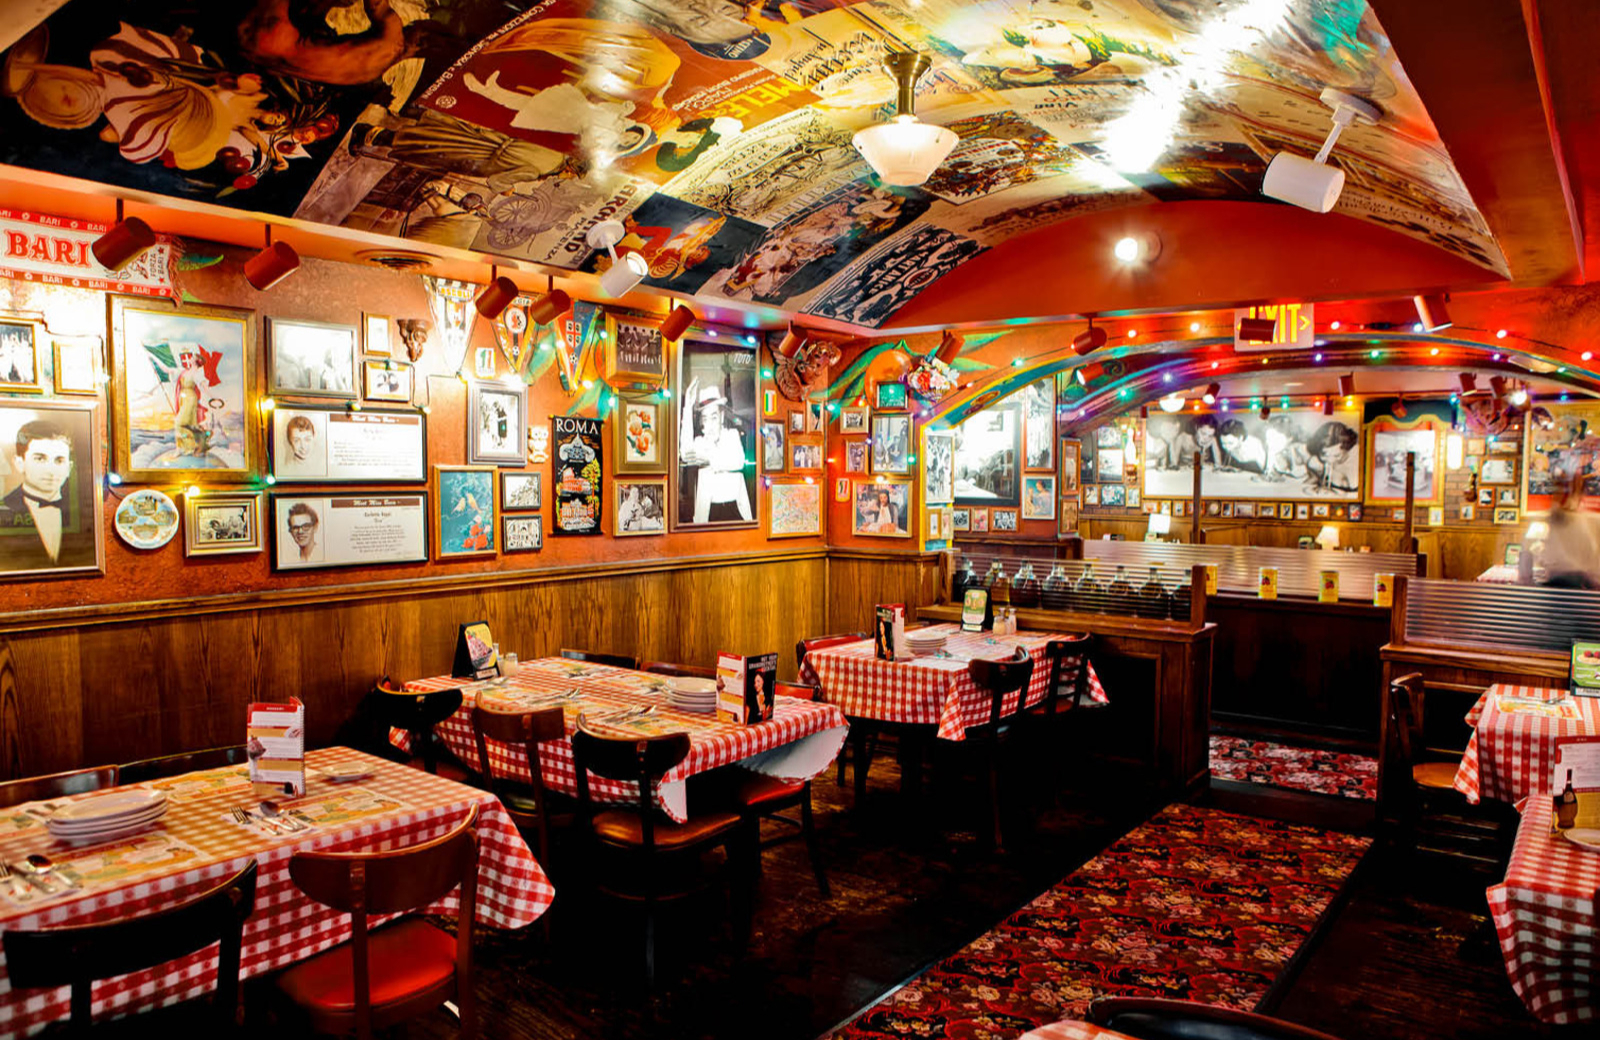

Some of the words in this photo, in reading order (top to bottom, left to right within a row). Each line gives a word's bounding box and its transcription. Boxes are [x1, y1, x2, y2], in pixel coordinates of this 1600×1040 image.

[422, 70, 453, 99] BAMBINI
[715, 77, 805, 118] MELE
[39, 216, 61, 226] BARI
[87, 223, 107, 232] BARI
[5, 229, 92, 268] BARI
[543, 217, 588, 261] PIACENZA
[42, 275, 63, 284] BARI
[88, 281, 108, 289] BARI
[132, 286, 150, 295] BARI
[440, 287, 471, 299] ASCOLI
[555, 418, 599, 435] ROMA
